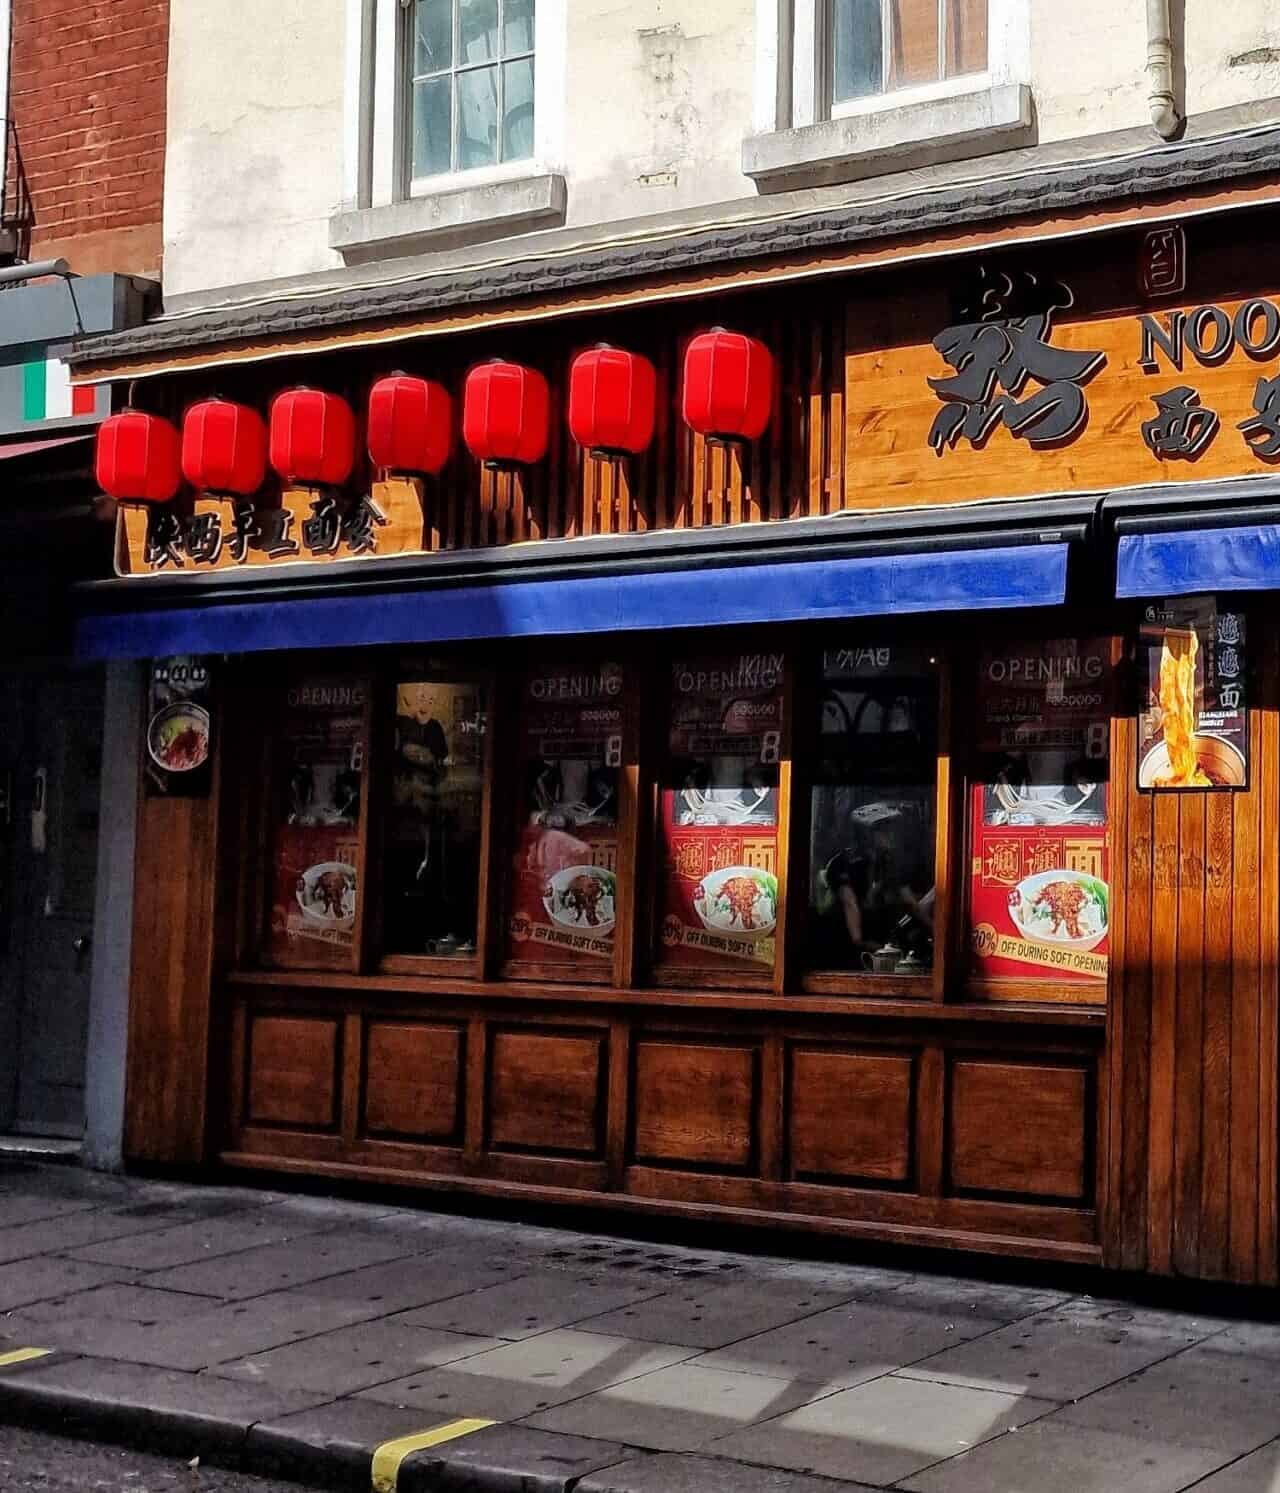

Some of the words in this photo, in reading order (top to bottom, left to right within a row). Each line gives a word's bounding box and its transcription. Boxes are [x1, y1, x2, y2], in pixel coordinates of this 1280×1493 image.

[680, 669, 777, 692] OPENING
[989, 655, 1104, 682] OPENING
[529, 671, 624, 698] OPENING
[1001, 940, 1016, 953] OFF
[1018, 943, 1049, 961] DURING
[1049, 949, 1073, 965] SOFT
